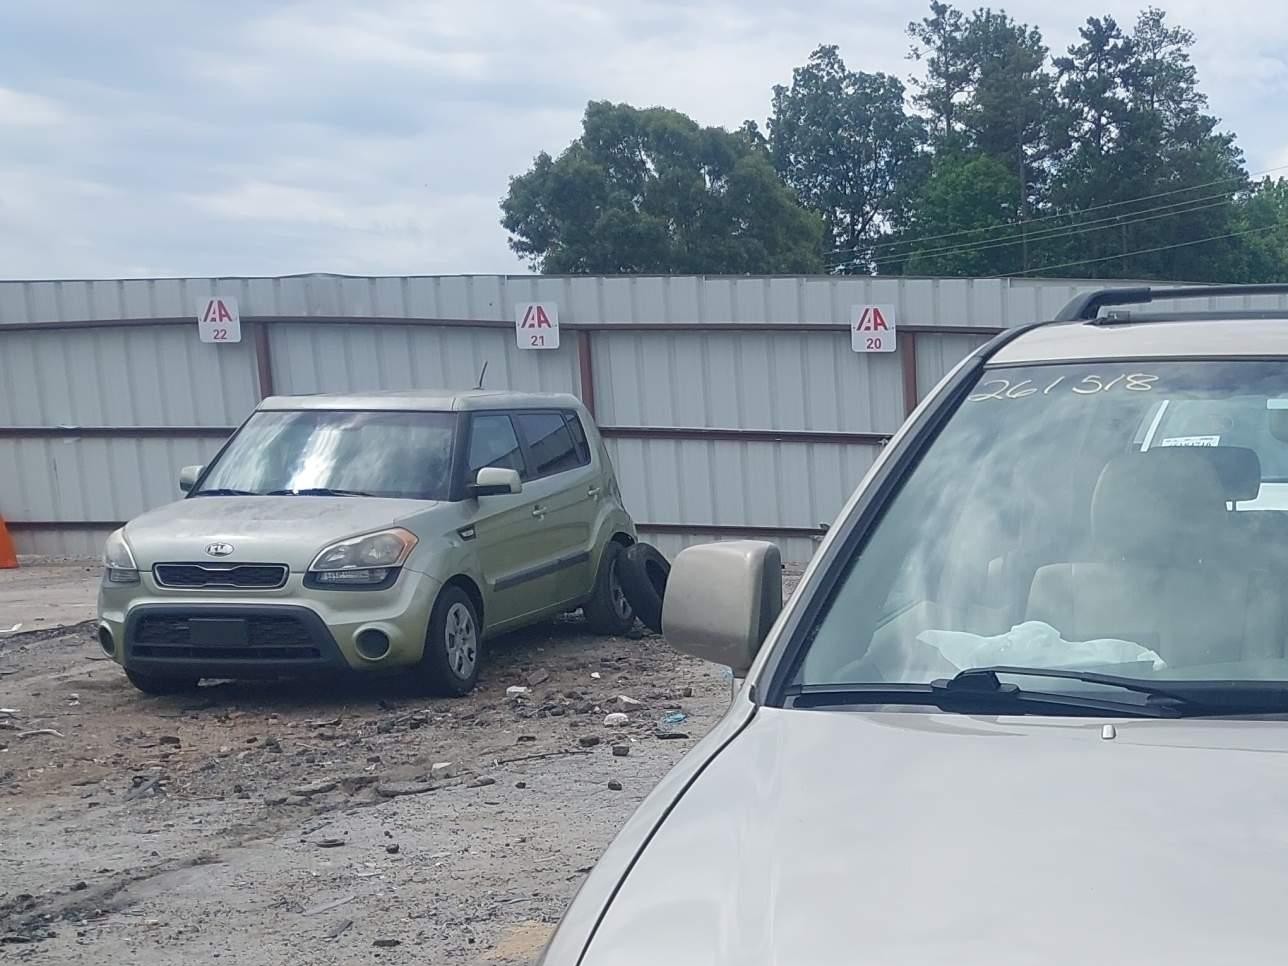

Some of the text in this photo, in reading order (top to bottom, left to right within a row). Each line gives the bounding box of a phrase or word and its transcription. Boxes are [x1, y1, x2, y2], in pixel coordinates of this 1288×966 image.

[213, 328, 227, 340] 22
[530, 335, 545, 347] 21
[866, 337, 882, 350] 20
